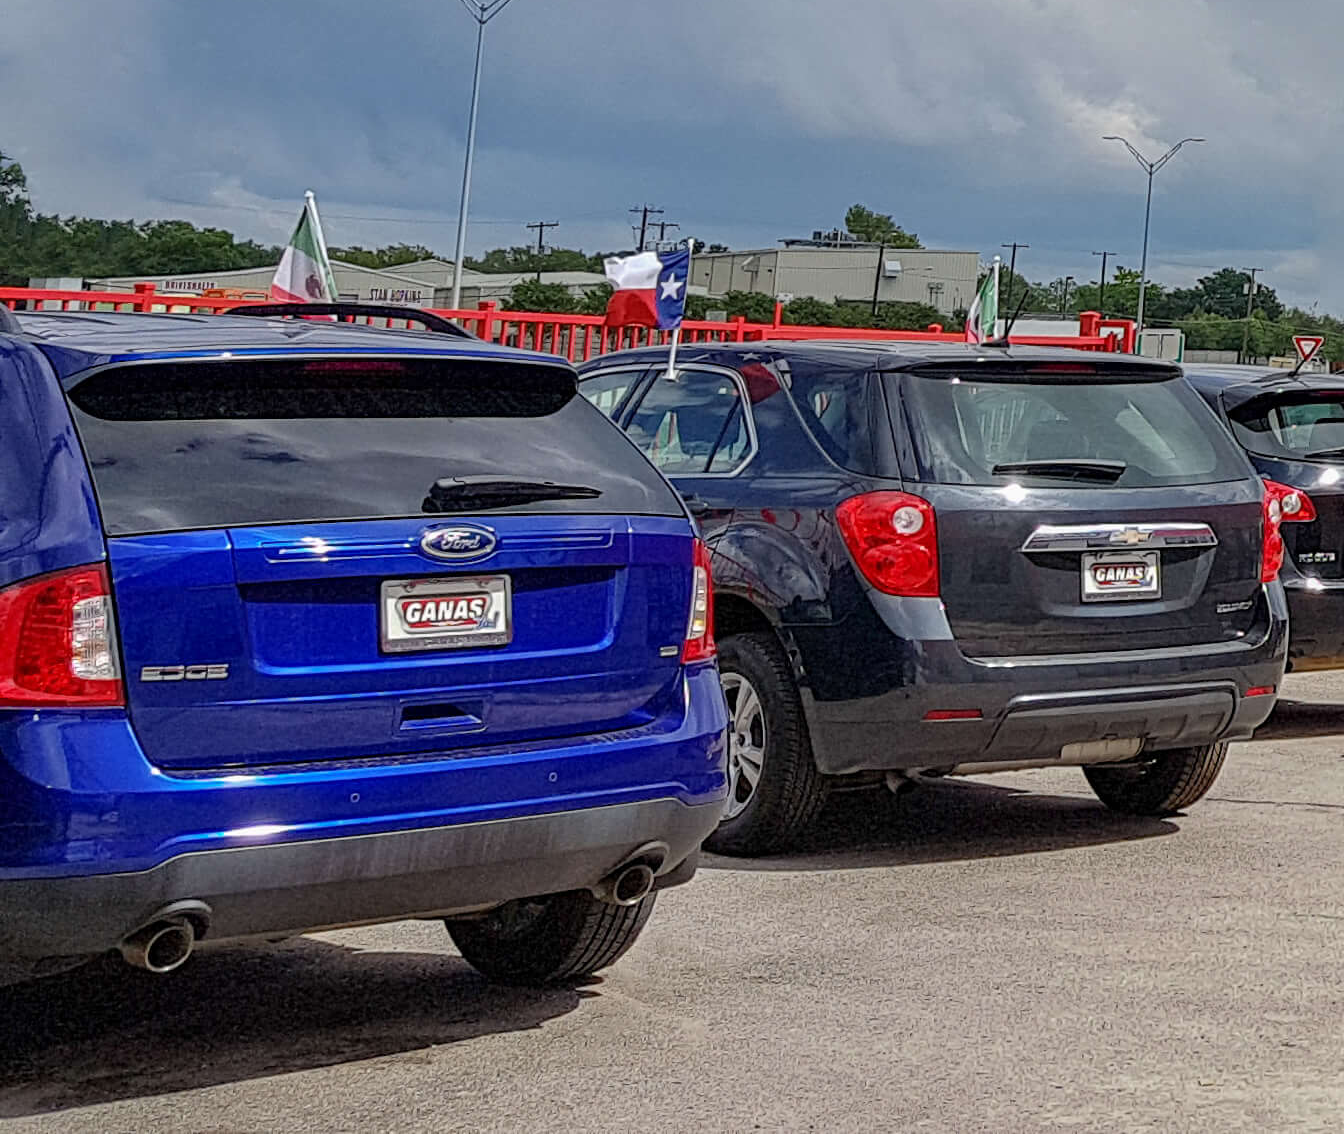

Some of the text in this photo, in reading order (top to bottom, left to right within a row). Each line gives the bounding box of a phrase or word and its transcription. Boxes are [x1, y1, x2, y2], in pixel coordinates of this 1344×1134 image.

[441, 531, 481, 550] Ford
[1095, 566, 1144, 582] GANAS
[405, 598, 484, 624] GANAS
[141, 663, 229, 682] EDGE
